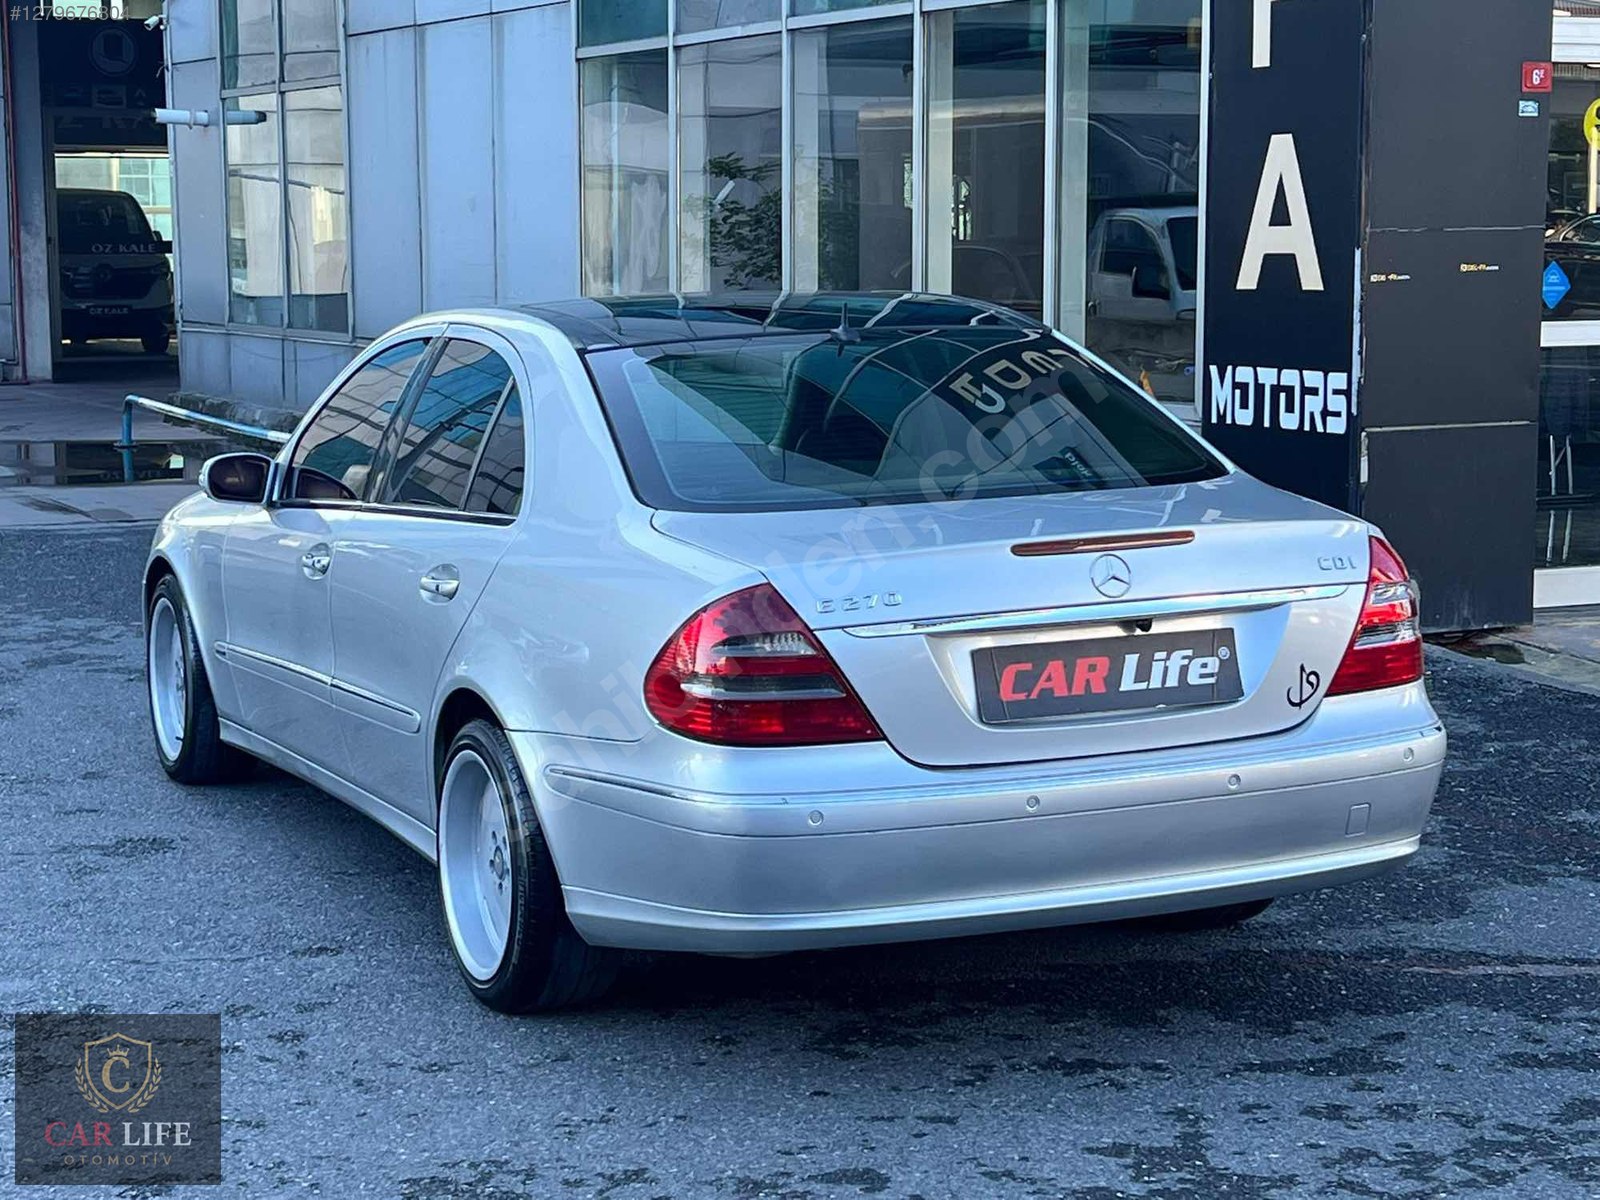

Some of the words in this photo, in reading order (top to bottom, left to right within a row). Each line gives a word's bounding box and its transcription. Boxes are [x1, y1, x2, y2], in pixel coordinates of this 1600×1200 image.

[119, 243, 156, 253] KALE
[1209, 364, 1348, 434] MOTORS
[1317, 556, 1357, 571] CDI
[842, 592, 902, 612] 270
[1000, 656, 1110, 702] CAR
